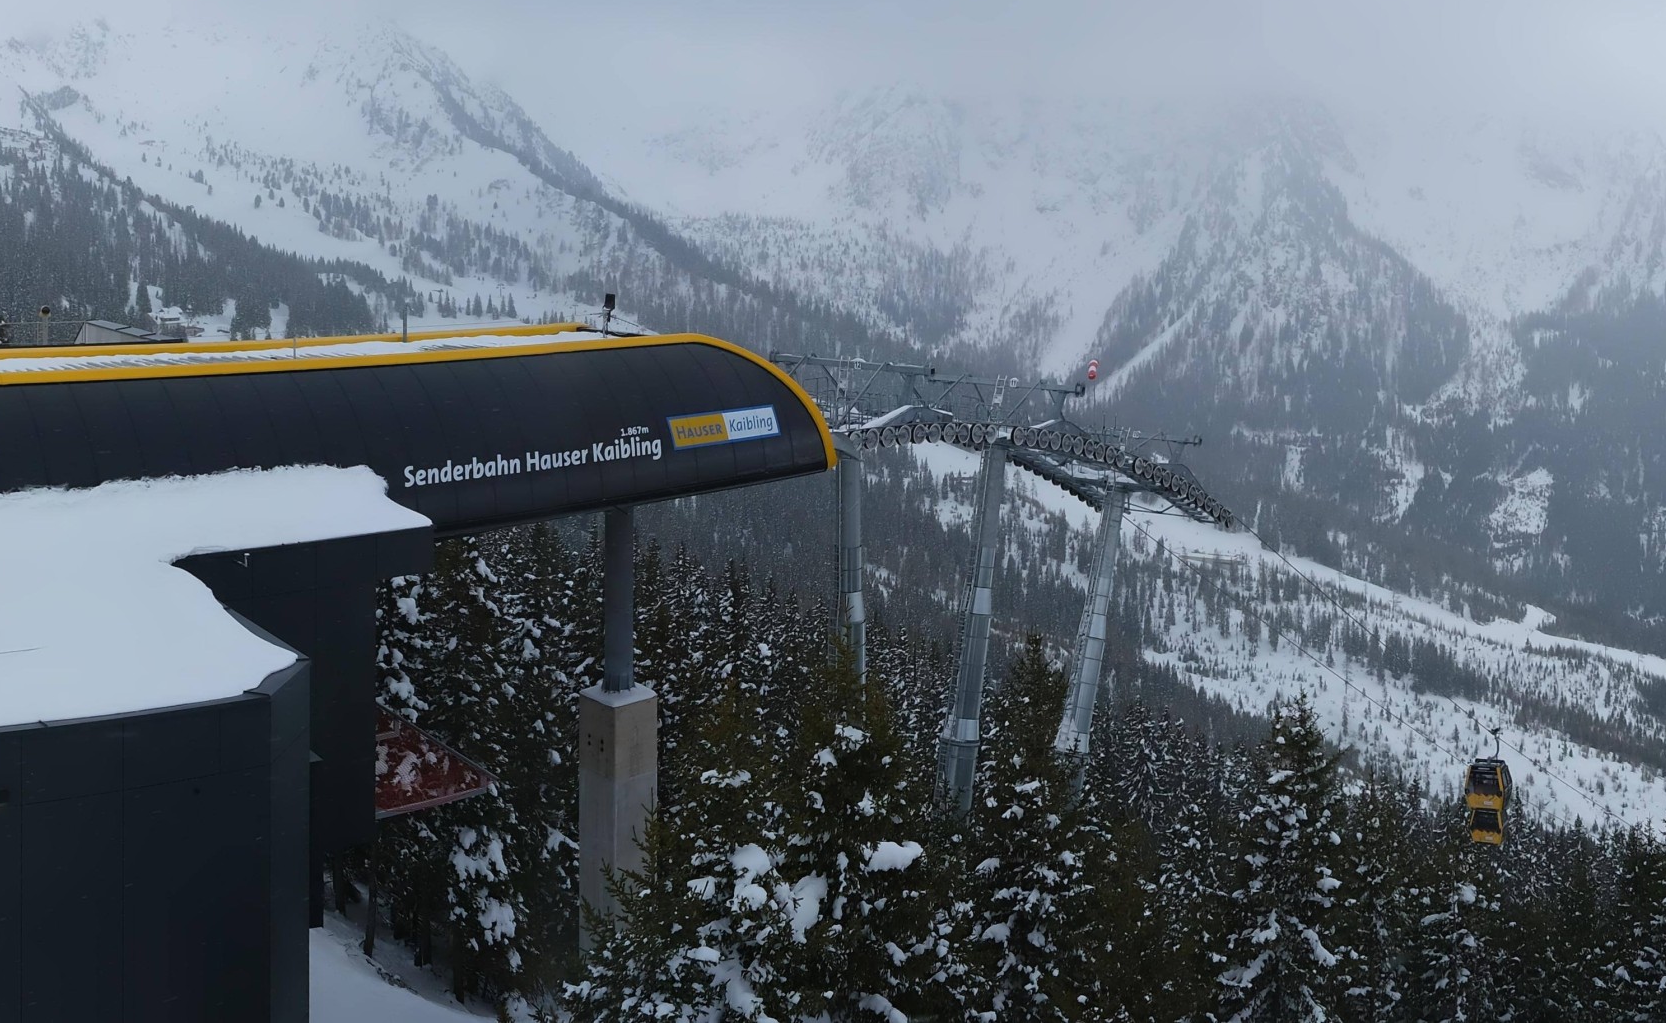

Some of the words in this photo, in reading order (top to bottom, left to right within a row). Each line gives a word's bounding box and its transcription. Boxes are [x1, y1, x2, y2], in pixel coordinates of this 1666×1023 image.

[620, 426, 649, 436] 1.867m
[675, 423, 723, 440] HAUSER
[729, 415, 773, 432] Kaibling
[403, 454, 521, 488] Senderbahn
[526, 448, 588, 472] Hauser
[592, 436, 662, 460] Kaibling
